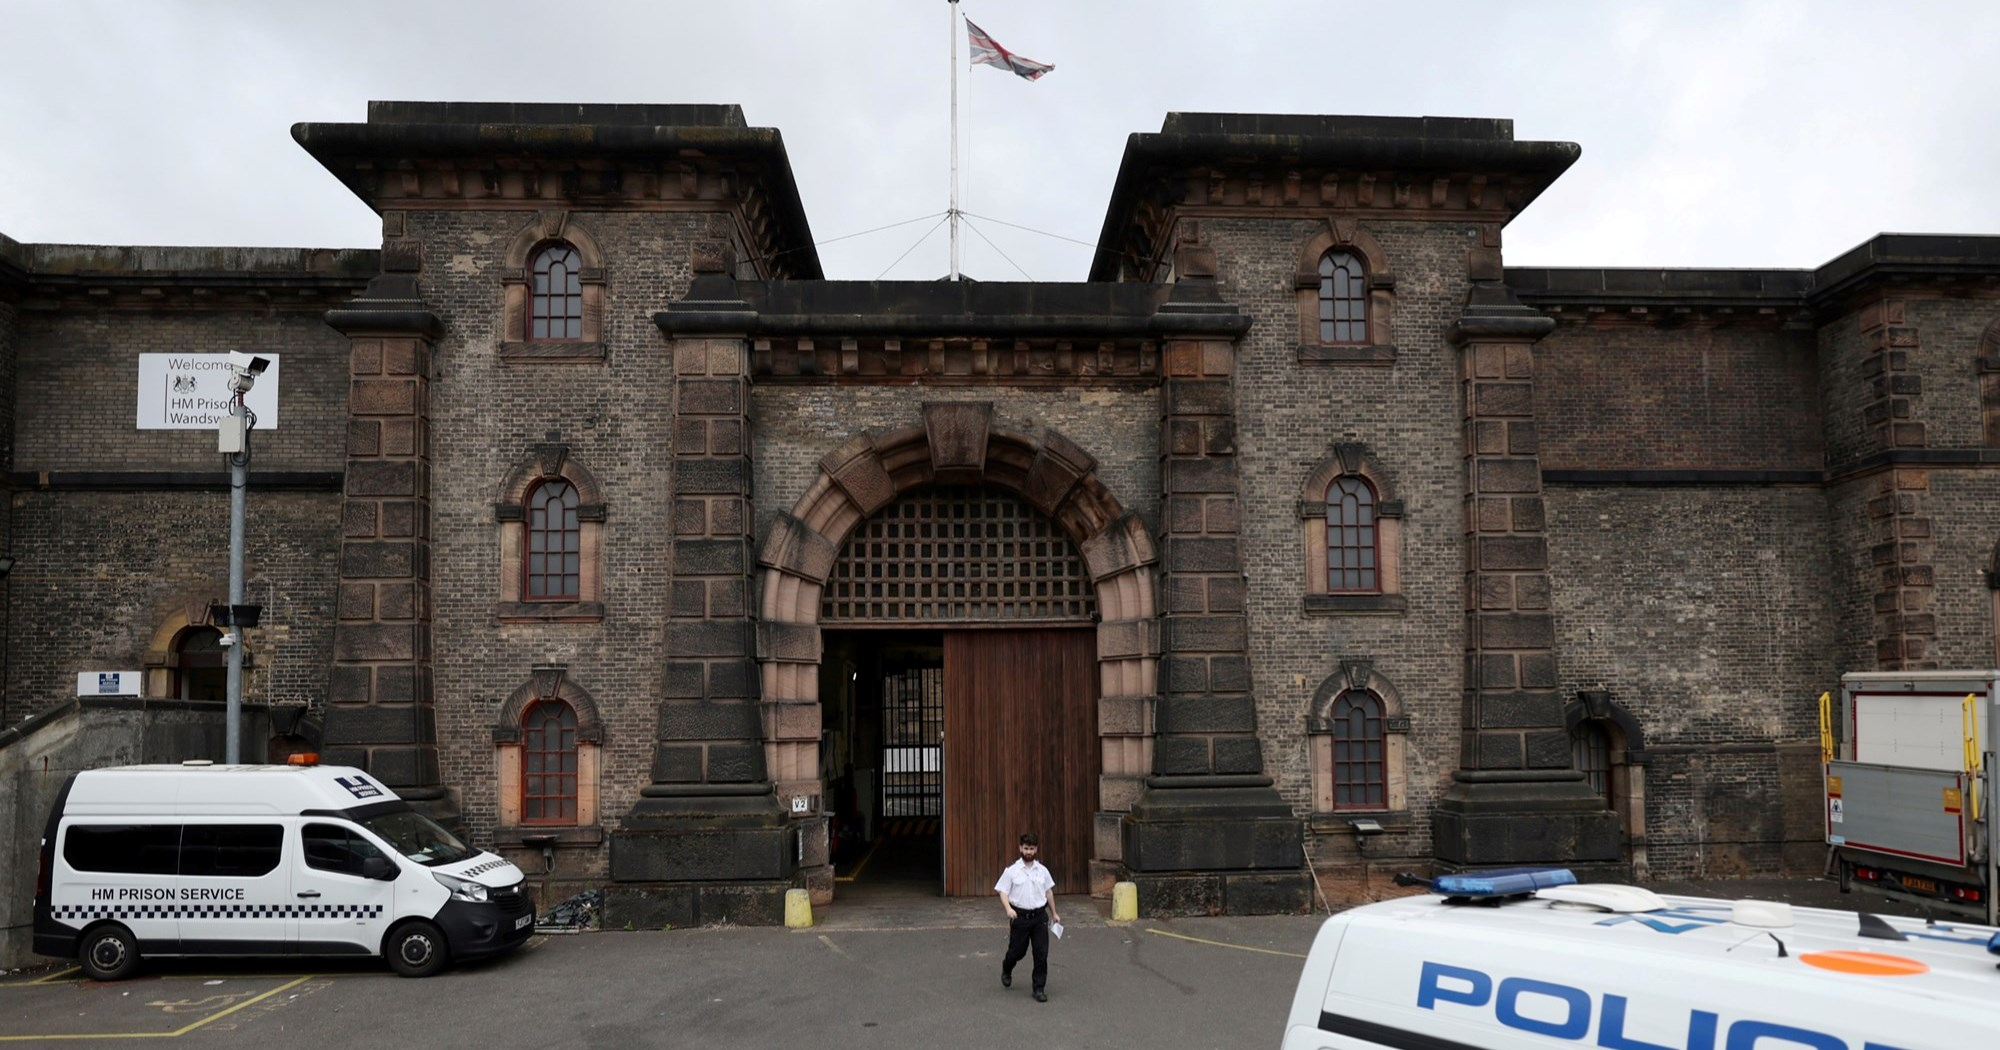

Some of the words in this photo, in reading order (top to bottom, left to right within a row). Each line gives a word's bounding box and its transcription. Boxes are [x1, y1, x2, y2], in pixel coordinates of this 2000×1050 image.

[168, 358, 232, 370] Welcome
[171, 398, 194, 409] HM
[170, 412, 231, 424] Wandsw
[794, 800, 806, 808] V2
[92, 888, 114, 900] HM
[119, 888, 176, 900] PRISON
[180, 888, 244, 900] SERVICE
[1416, 960, 1910, 1050] POLI
